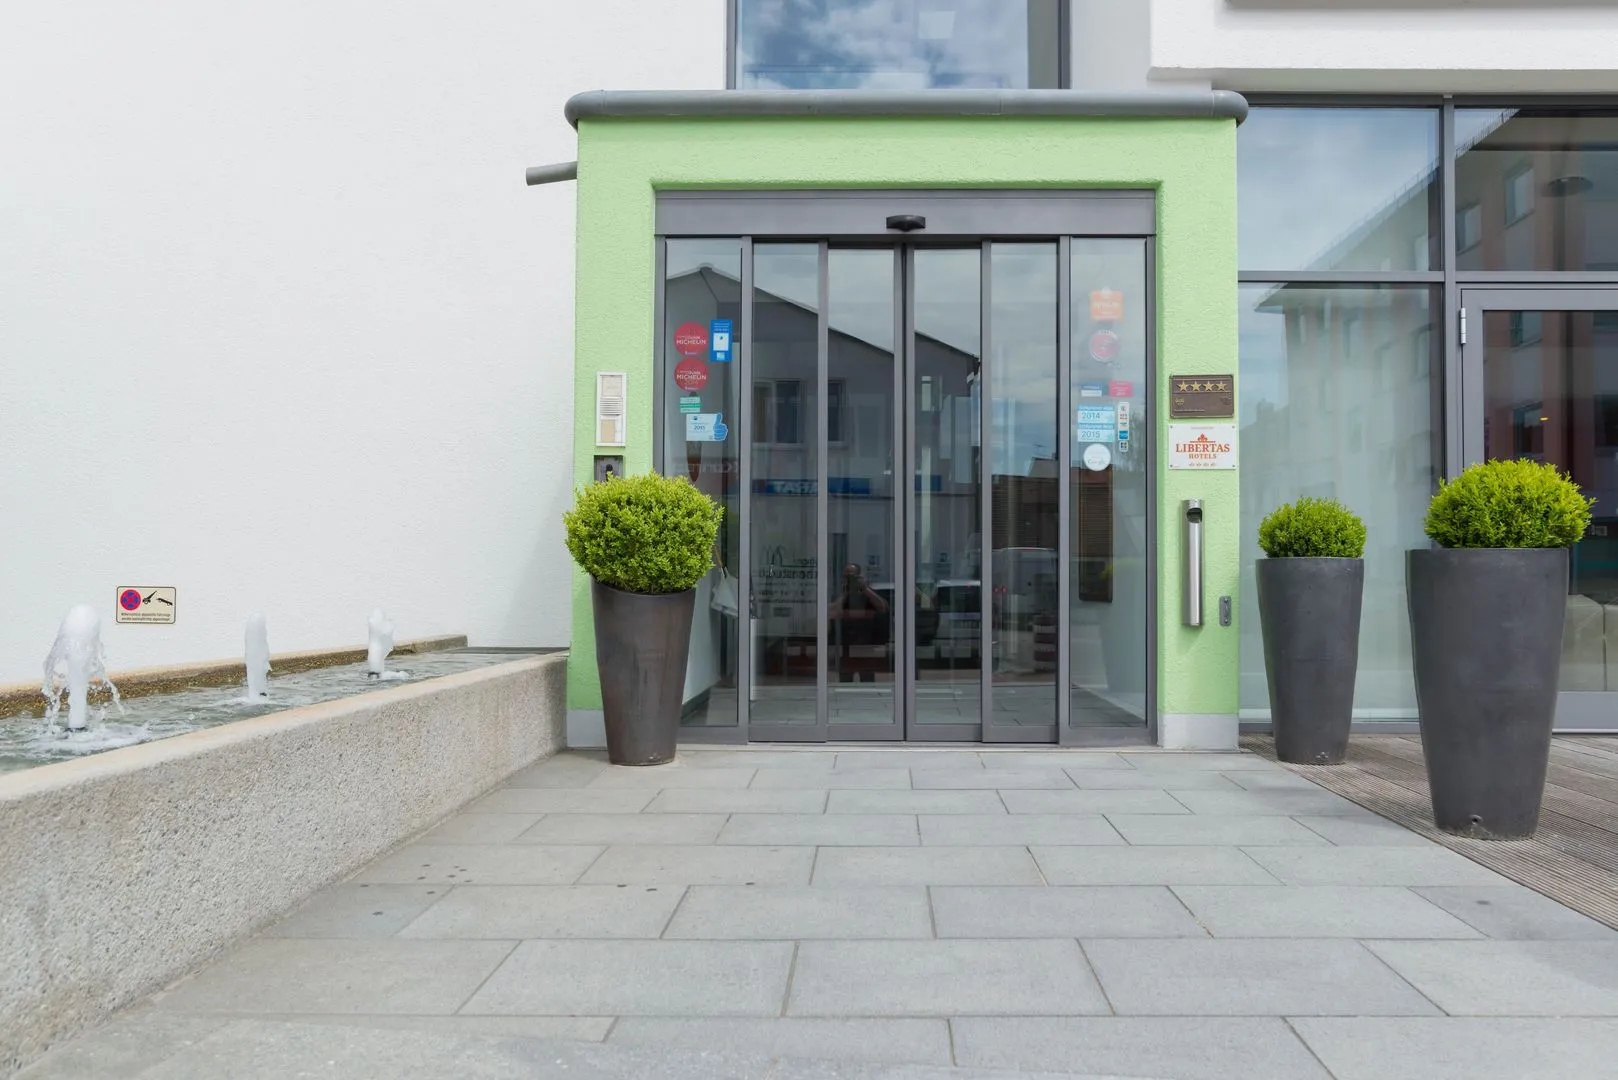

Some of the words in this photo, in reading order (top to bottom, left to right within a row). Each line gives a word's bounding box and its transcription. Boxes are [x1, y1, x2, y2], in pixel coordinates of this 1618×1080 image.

[1081, 412, 1101, 420] 2014
[1081, 430, 1101, 438] 2015
[1175, 443, 1231, 453] LIBERTAS
